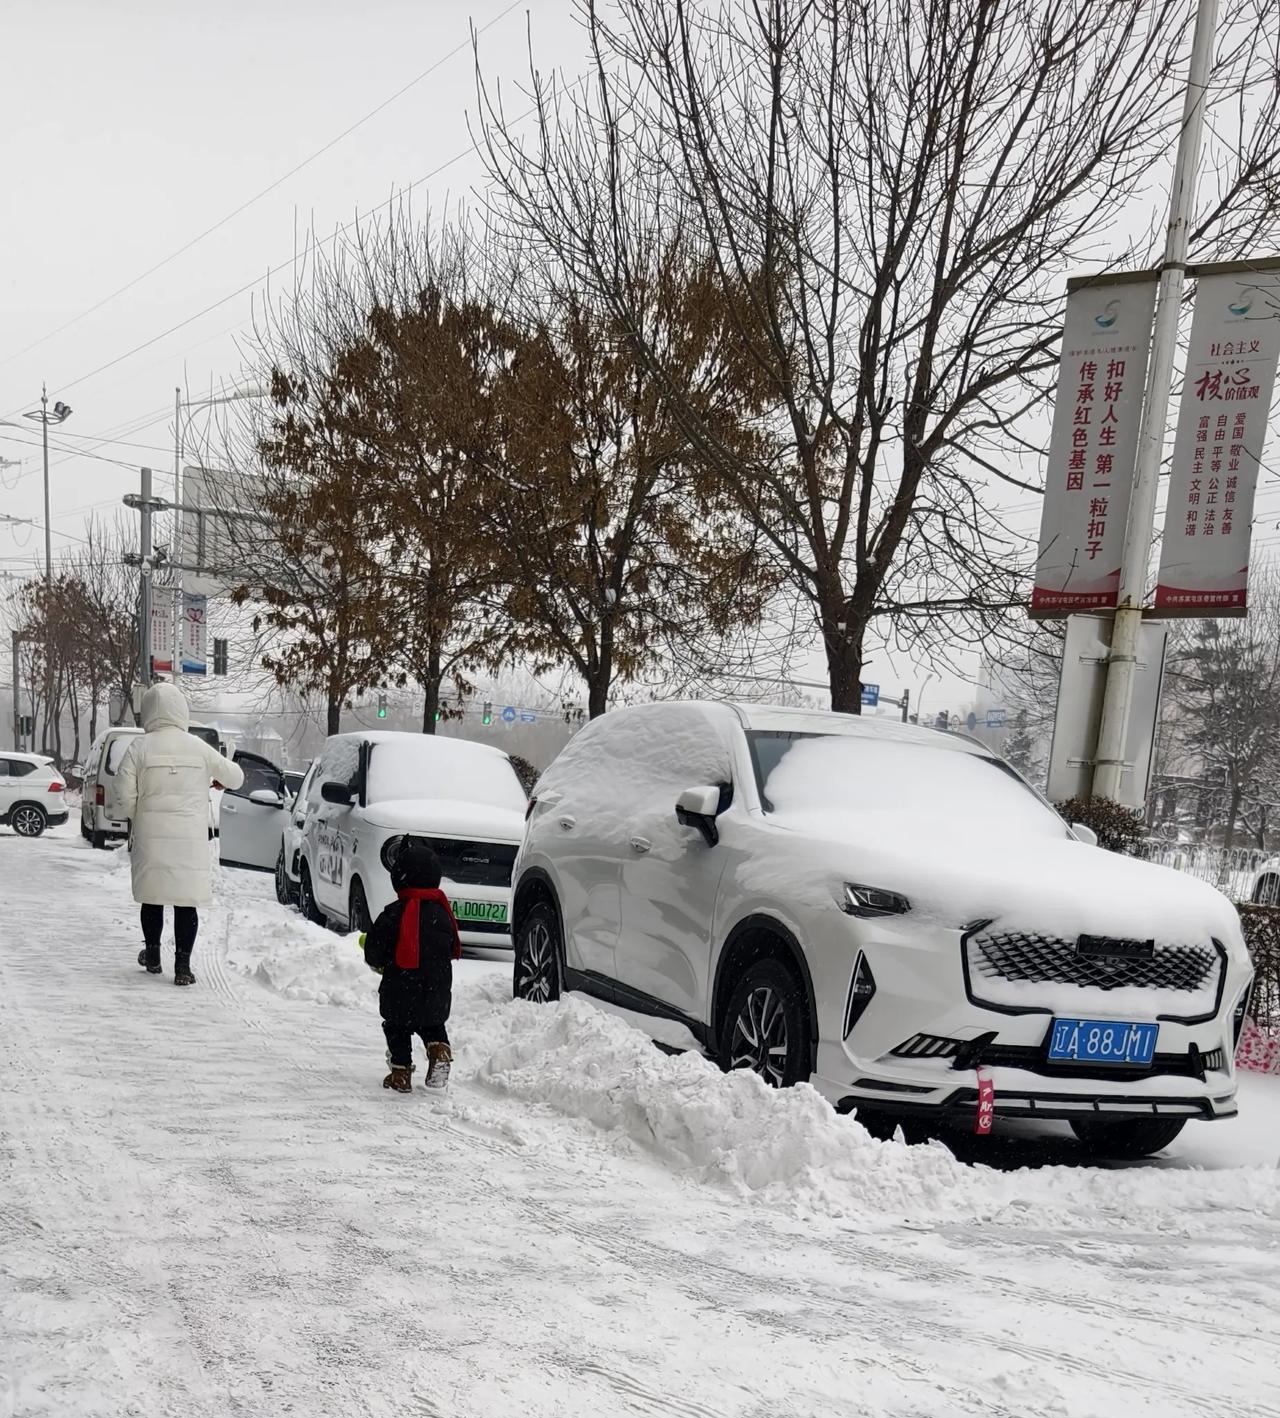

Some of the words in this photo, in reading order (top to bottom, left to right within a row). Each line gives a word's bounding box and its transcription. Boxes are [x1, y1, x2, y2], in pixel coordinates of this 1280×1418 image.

[1211, 340, 1260, 357] 社会主义
[1066, 361, 1098, 491] 传承红色基因
